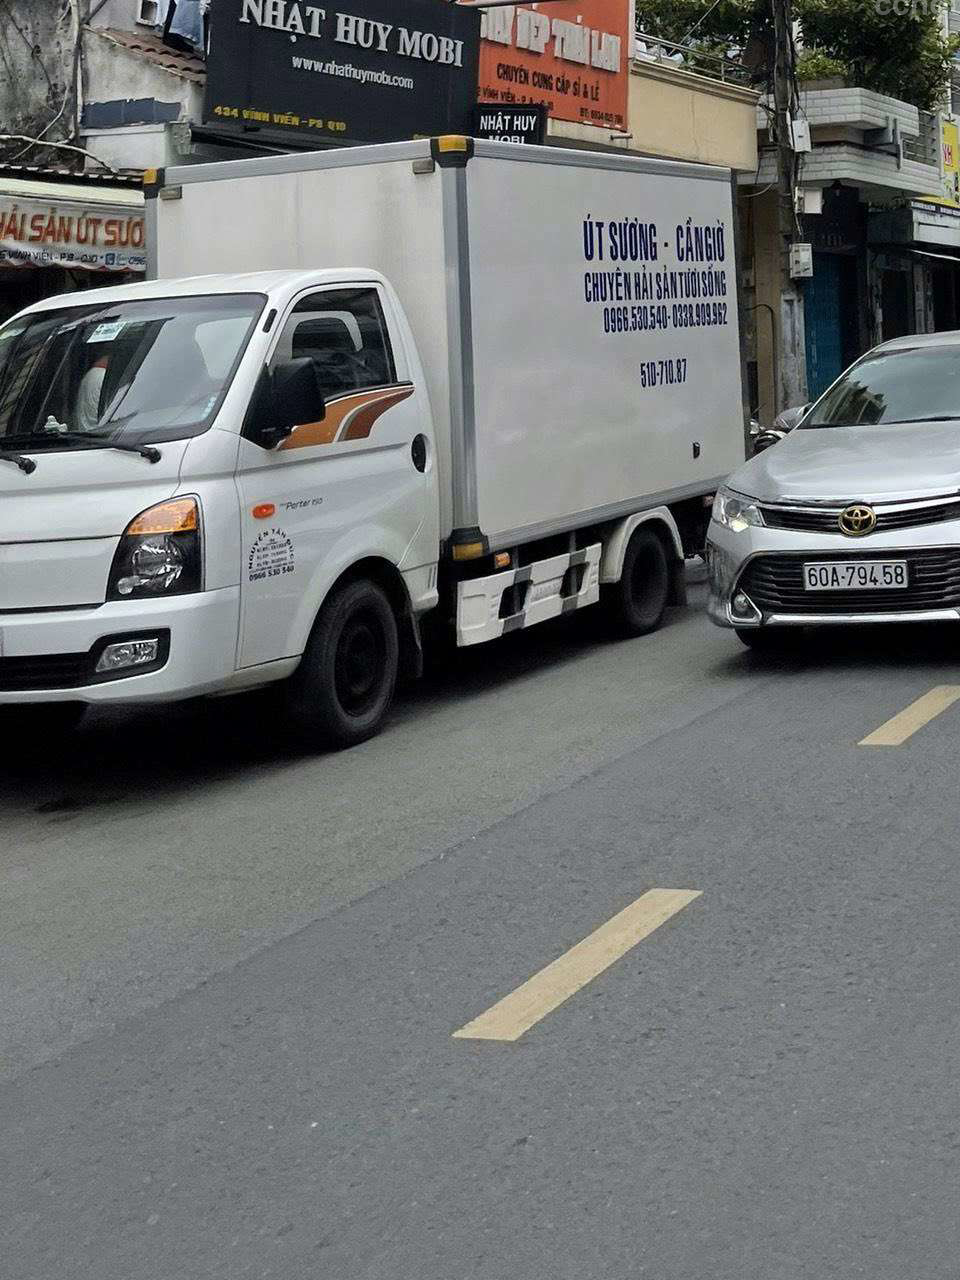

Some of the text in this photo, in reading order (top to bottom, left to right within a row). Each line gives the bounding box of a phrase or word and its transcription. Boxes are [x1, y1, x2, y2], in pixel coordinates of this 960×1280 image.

[334, 12, 393, 53] HUY
[396, 27, 465, 68] MOBI
[292, 56, 414, 90] www.nhathuymobi.com
[214, 105, 239, 119] 434
[480, 111, 537, 133] NHẬT HUY
[583, 214, 604, 261] ÚT
[608, 217, 657, 261] SƯƠNG
[584, 263, 726, 302] CHUYÊN HẢI SẢN TƯƠI SỐNG
[640, 359, 687, 388] 51D-710.87
[807, 564, 905, 587] 60A-794.58
